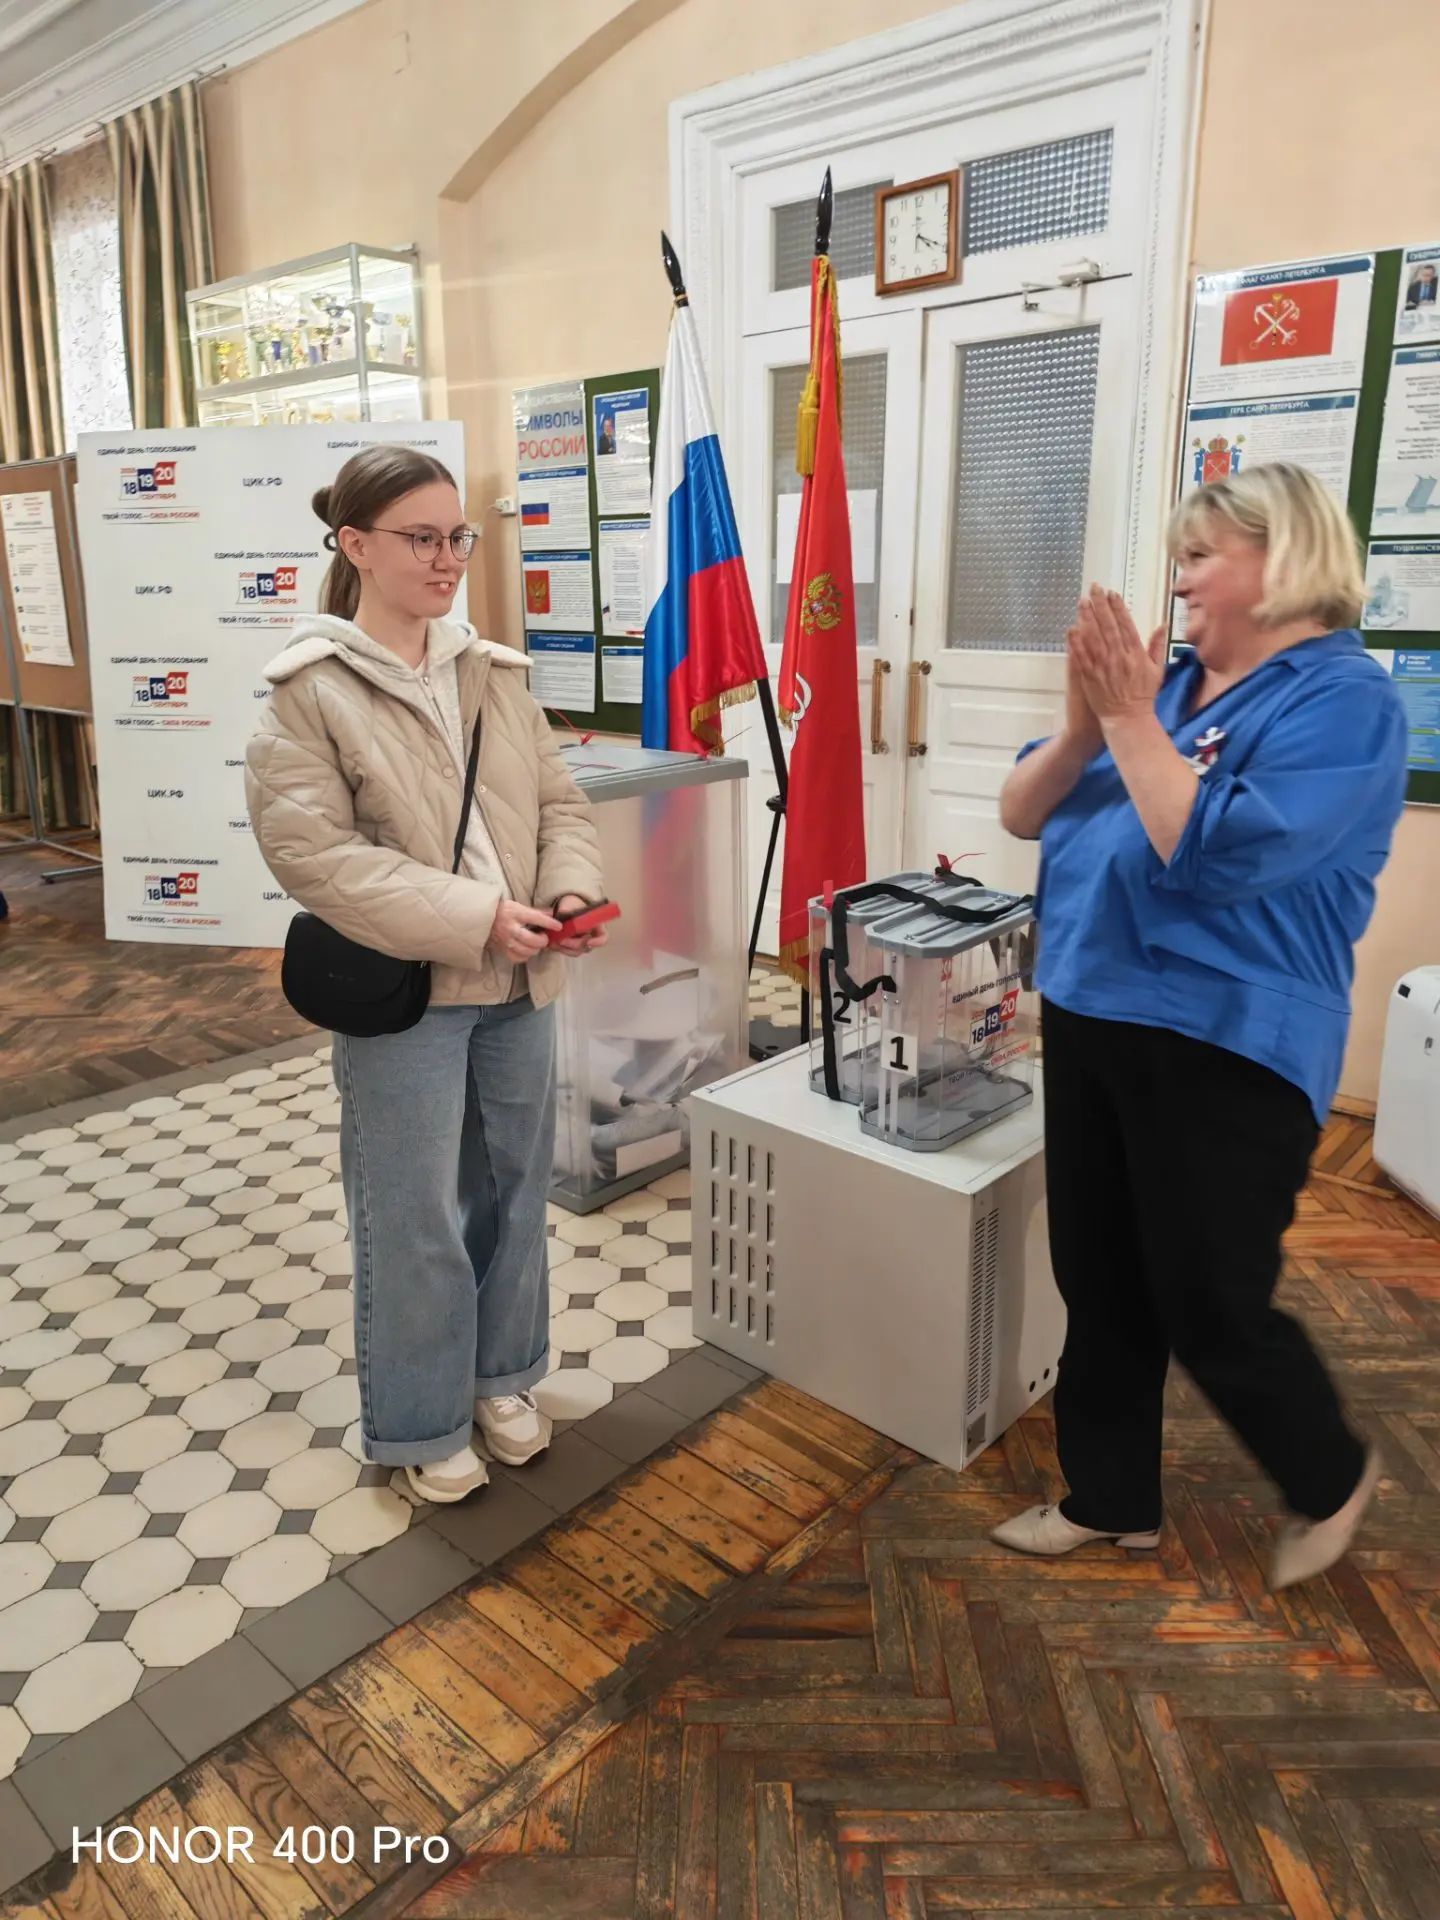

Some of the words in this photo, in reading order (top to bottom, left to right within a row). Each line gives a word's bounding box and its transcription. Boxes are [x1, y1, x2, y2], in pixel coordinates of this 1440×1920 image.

[518, 434, 585, 460] РОССИИ
[123, 482, 137, 494] 18
[139, 474, 154, 487] 19
[155, 467, 173, 480] 20
[243, 477, 282, 487] ЦИК.РФ
[136, 585, 172, 594] ЦИК.РФ
[242, 586, 256, 598] 18
[258, 578, 274, 592] 19
[277, 572, 294, 585] 20
[136, 690, 149, 702] 18
[151, 683, 166, 695] 19
[167, 677, 185, 689] 20
[147, 790, 184, 798] ЦИК.РФ
[147, 888, 161, 901] 18
[162, 882, 177, 894] 19
[178, 877, 196, 889] 20
[952, 986, 978, 1004] ЕДИНЫЙ
[979, 981, 995, 995] ДЕНЬ
[833, 991, 852, 1024] 2
[972, 1027, 985, 1044] 18
[987, 1012, 999, 1028] 19
[1001, 1000, 1015, 1016] 20
[890, 1036, 908, 1071] 1
